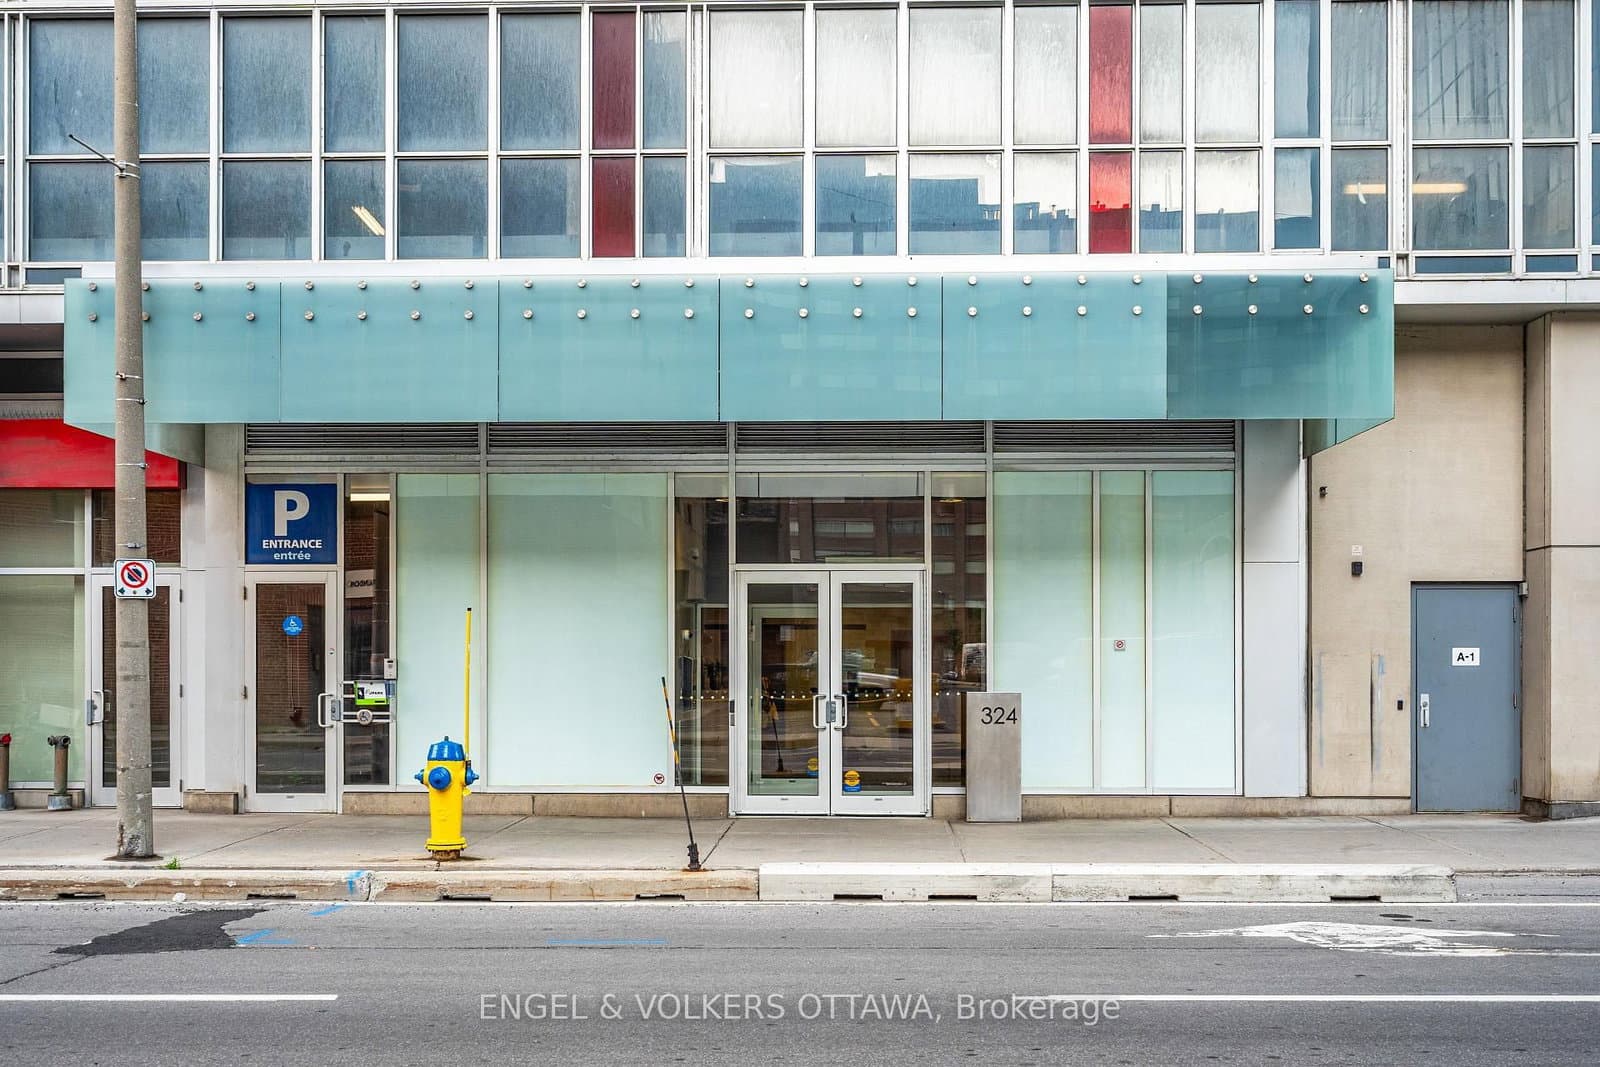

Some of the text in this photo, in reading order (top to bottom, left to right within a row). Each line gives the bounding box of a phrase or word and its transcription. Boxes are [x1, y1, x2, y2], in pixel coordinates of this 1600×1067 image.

[274, 490, 310, 537] P
[262, 539, 323, 549] ENTRANCE
[273, 551, 312, 560] entrée
[1457, 652, 1474, 662] A-1
[981, 706, 1018, 725] 324
